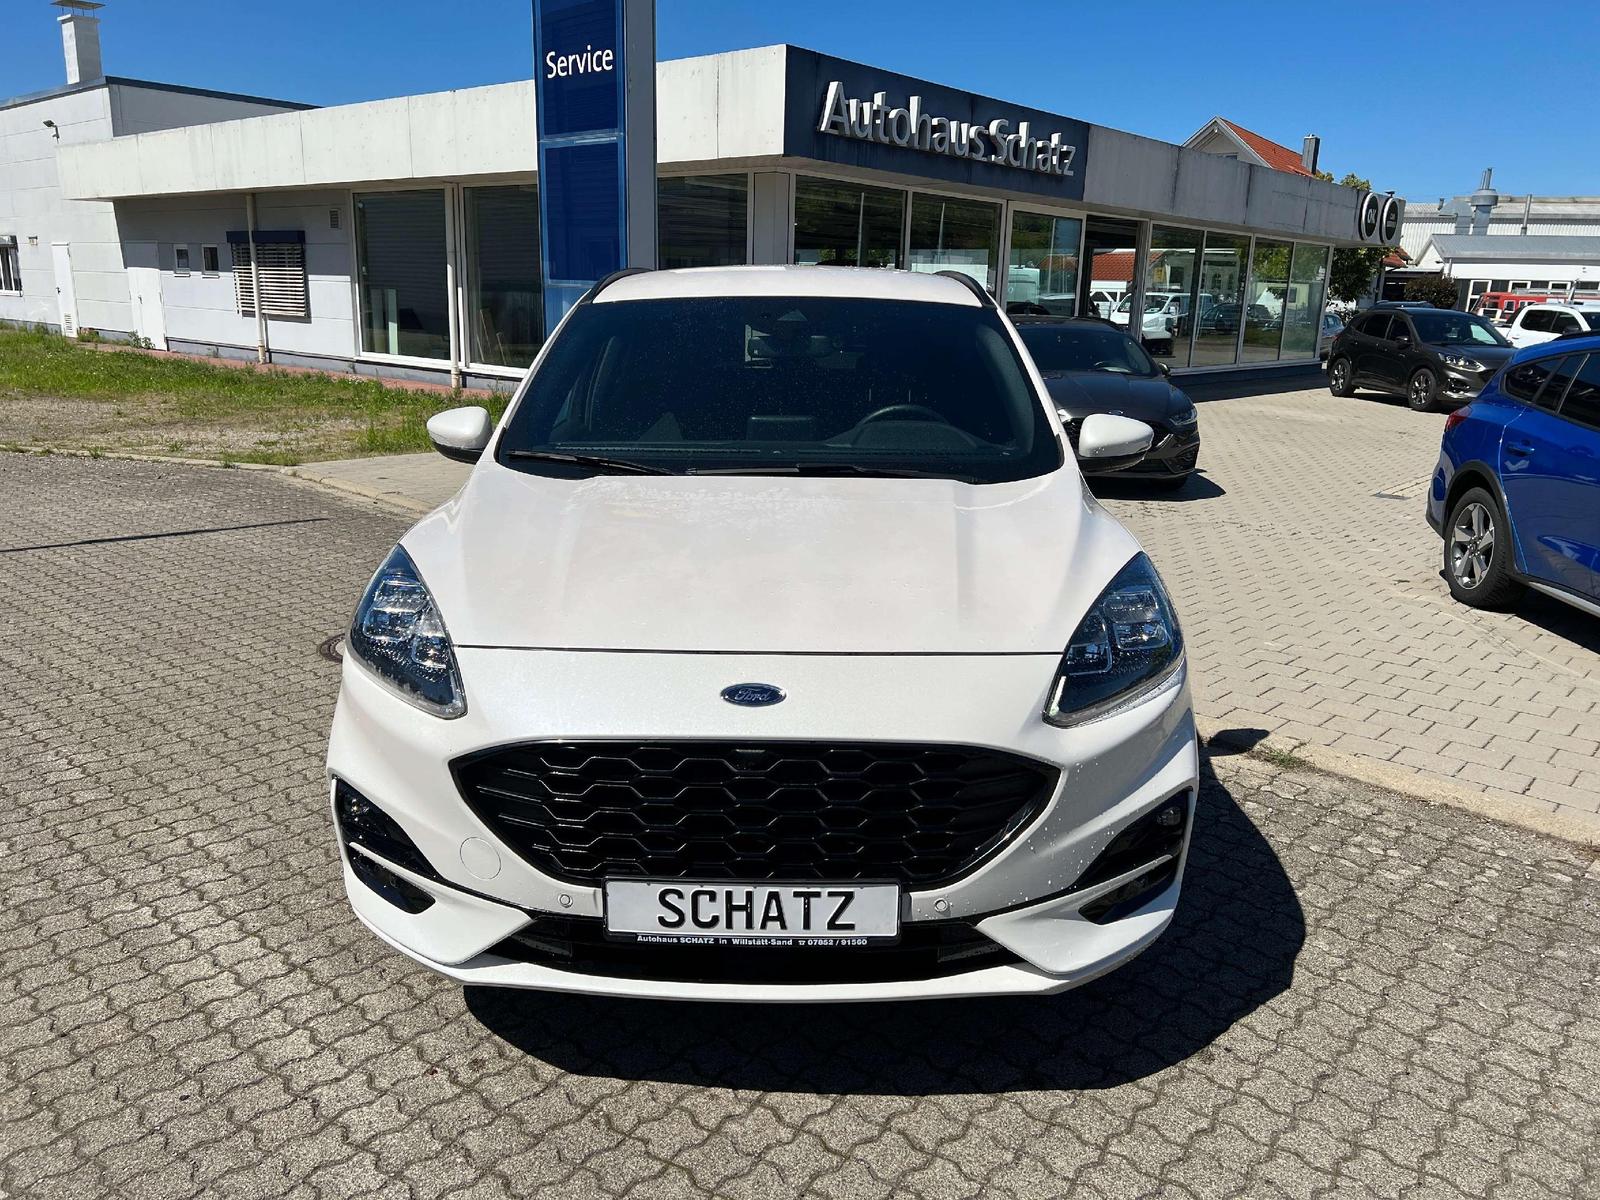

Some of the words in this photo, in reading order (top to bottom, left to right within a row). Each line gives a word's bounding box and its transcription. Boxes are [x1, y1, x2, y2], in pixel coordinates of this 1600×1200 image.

[546, 45, 613, 79] Service
[734, 688, 771, 701] Ford
[657, 888, 856, 931] SCHATZ
[637, 935, 678, 943] Autohaus
